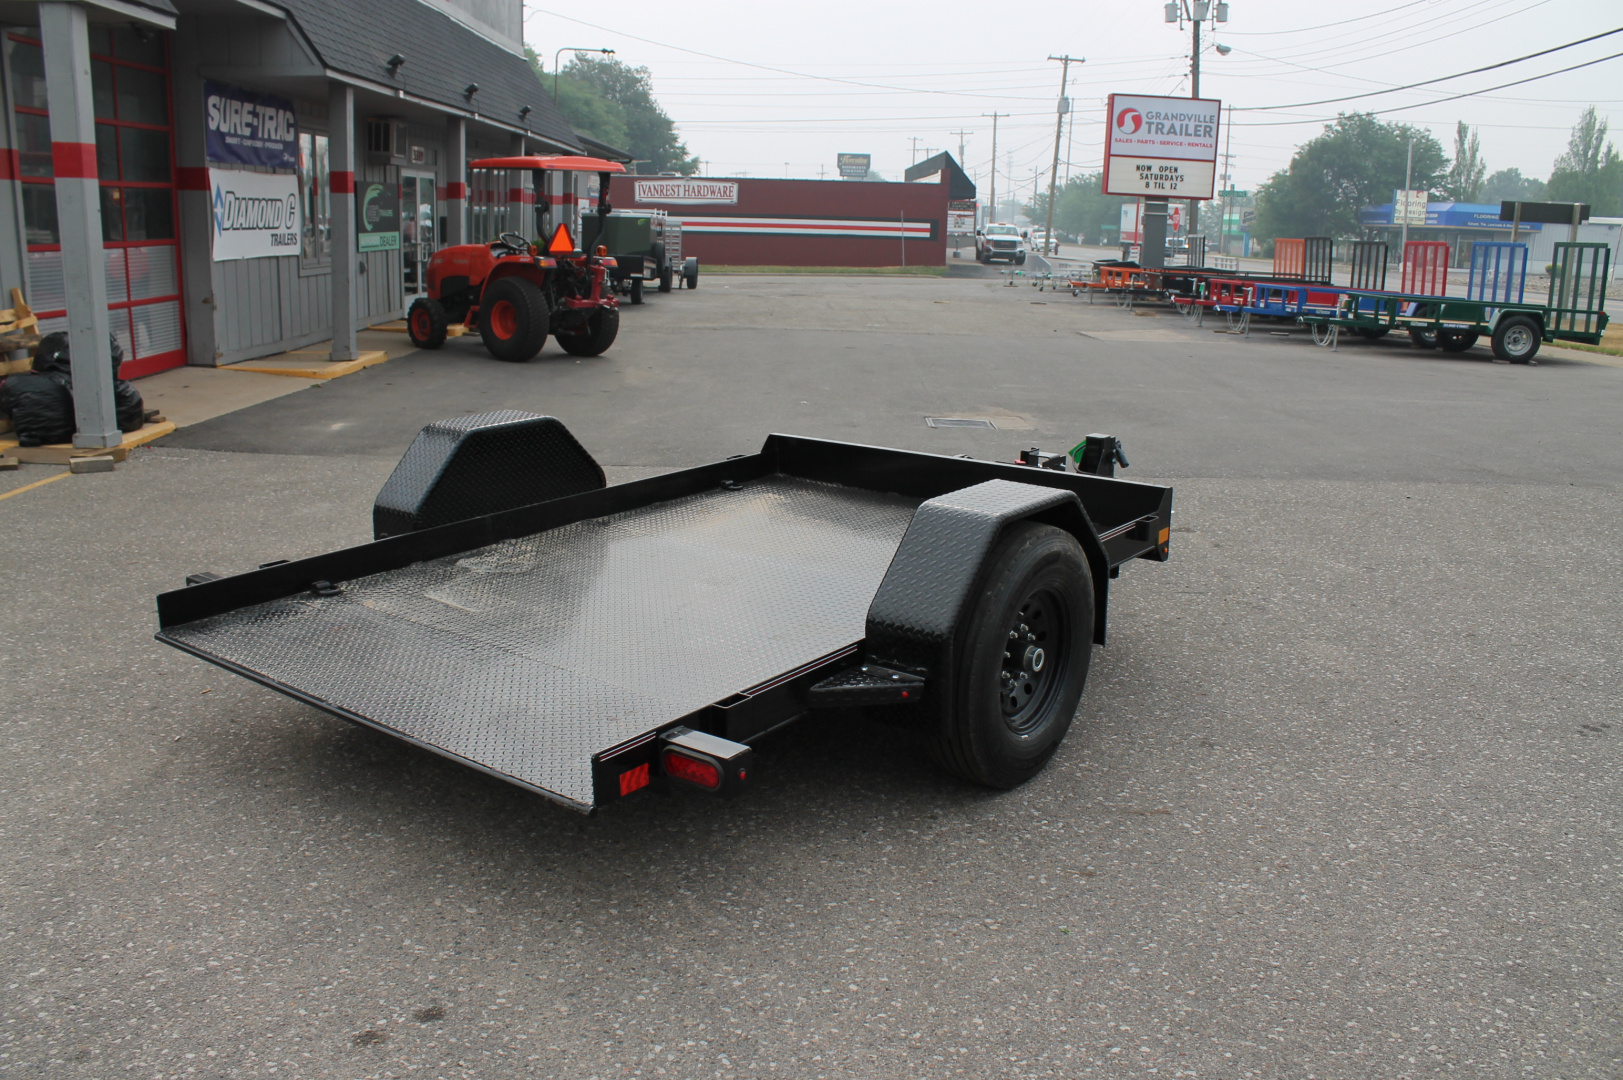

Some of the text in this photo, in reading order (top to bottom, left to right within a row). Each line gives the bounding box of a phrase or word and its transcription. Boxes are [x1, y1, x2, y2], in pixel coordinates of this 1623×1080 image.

[207, 95, 295, 142] SURE-TRAC
[1145, 111, 1216, 124] GRANDVILLE
[1145, 121, 1214, 138] TRAILER
[1135, 164, 1179, 174] NOW OPEN
[1139, 173, 1184, 182] SATURDAYS
[637, 184, 735, 198] IVANREST HARDWARE
[1154, 182, 1166, 190] TIL
[222, 191, 297, 231] DIAMOND C
[270, 233, 298, 246] TRAILERS
[379, 235, 397, 247] DEALER
